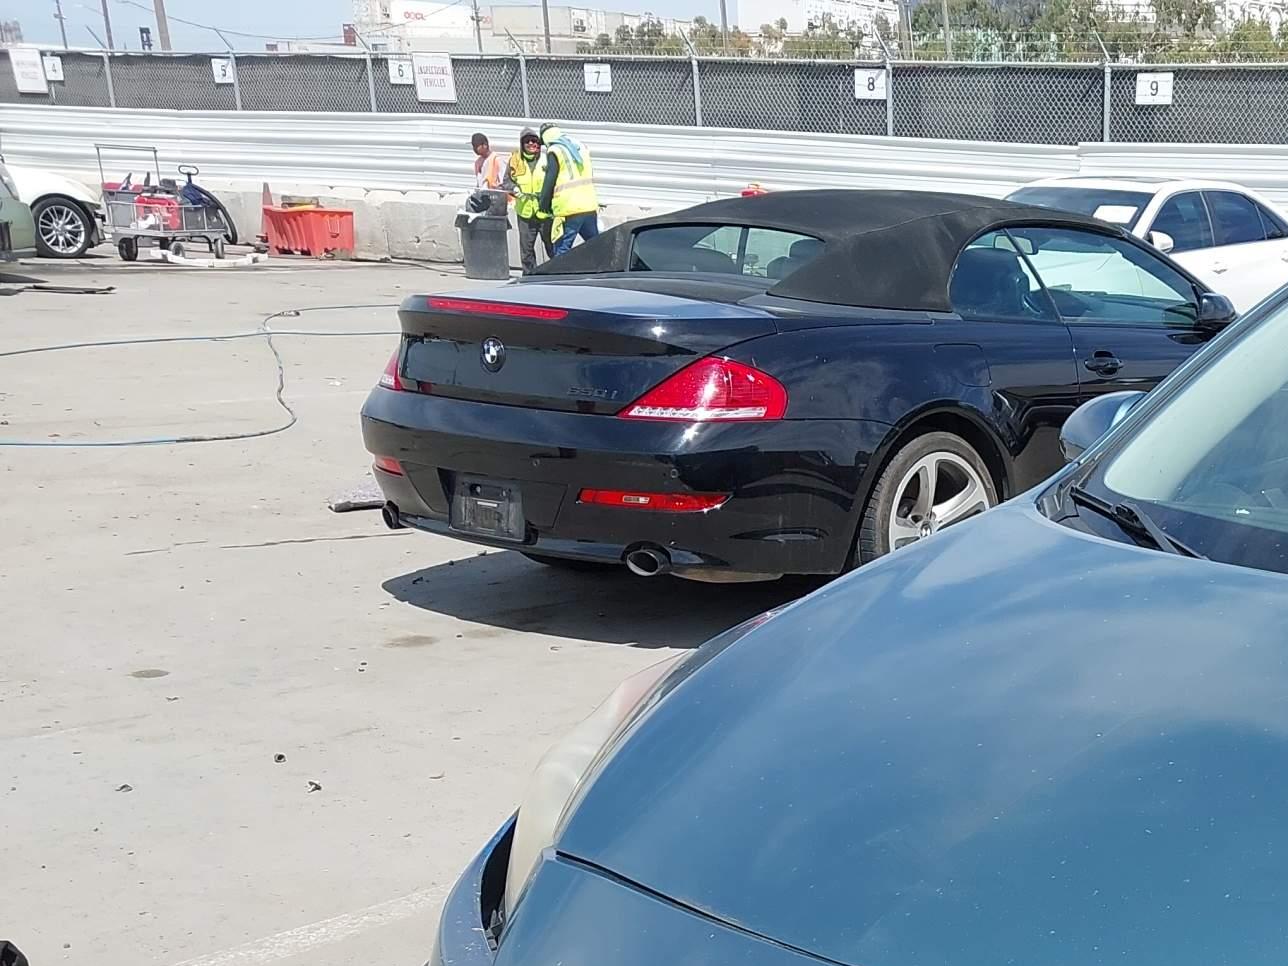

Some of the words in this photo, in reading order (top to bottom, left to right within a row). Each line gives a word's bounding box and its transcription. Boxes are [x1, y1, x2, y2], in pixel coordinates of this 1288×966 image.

[220, 64, 227, 77] 5
[397, 63, 404, 78] 6
[594, 70, 601, 85] 7
[867, 76, 875, 91] 8
[1150, 80, 1159, 97] 9
